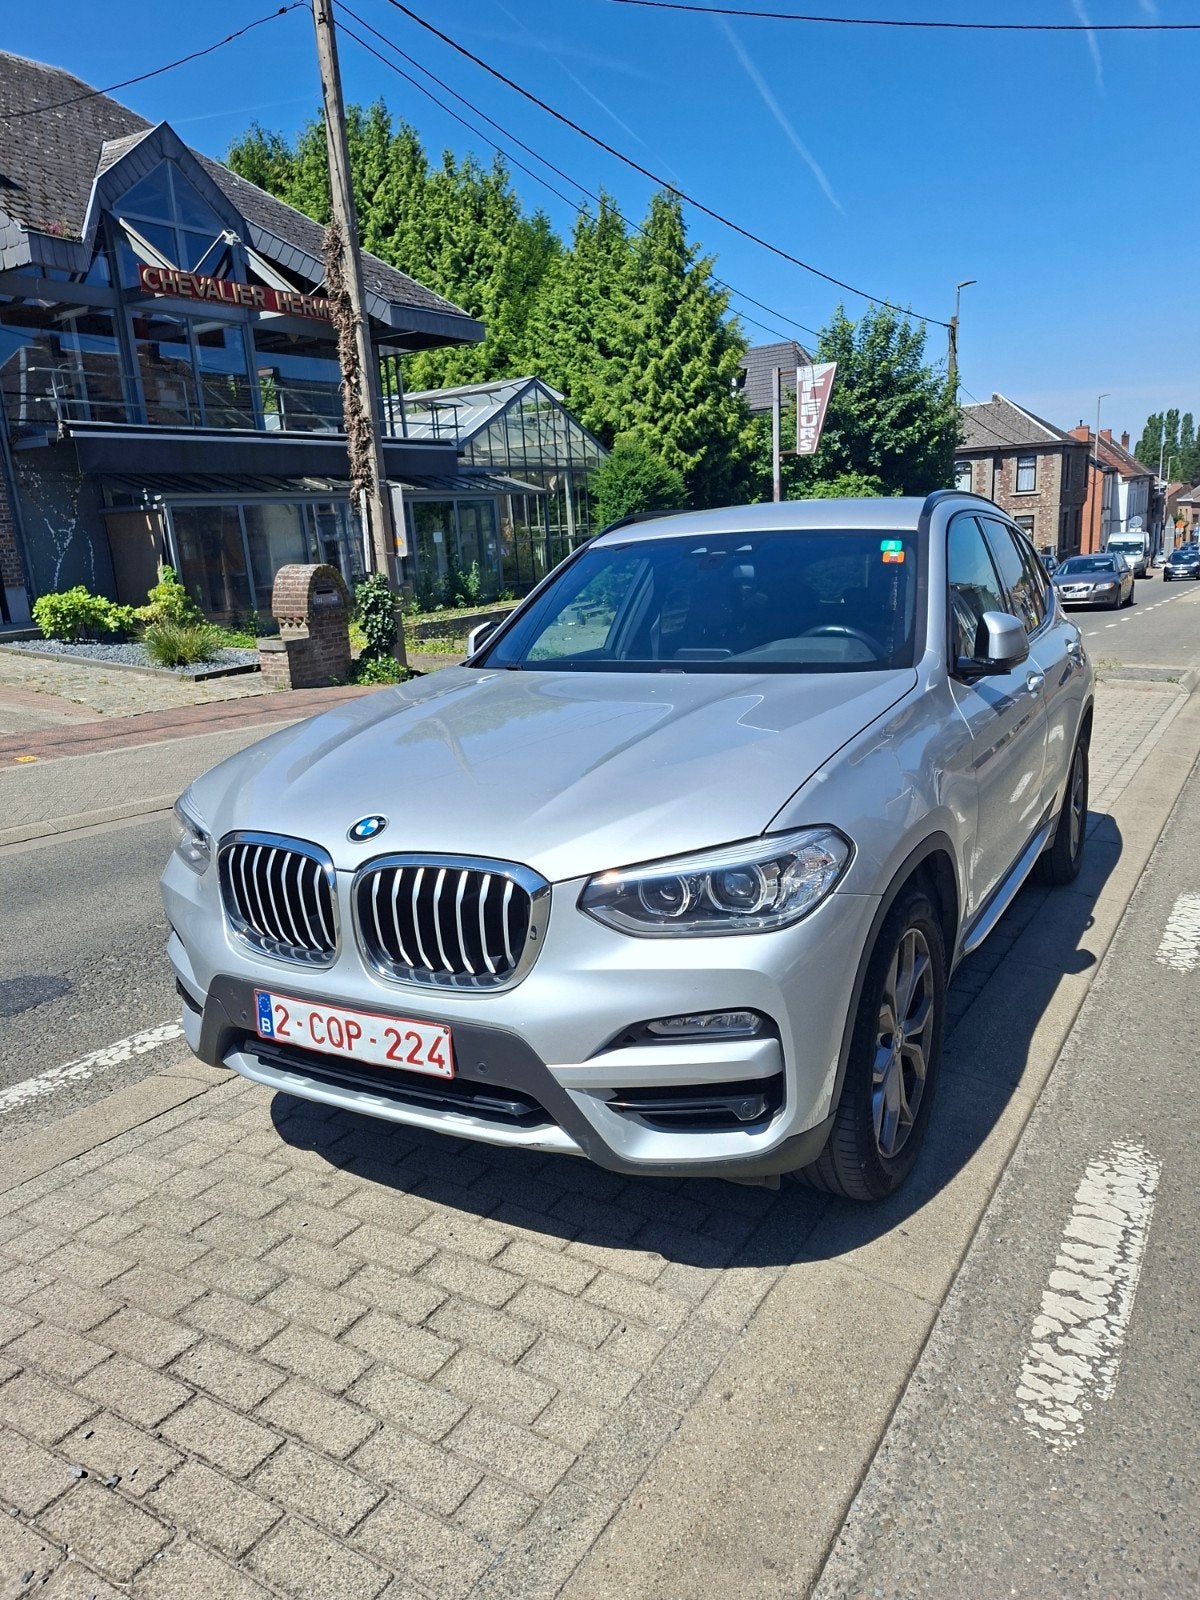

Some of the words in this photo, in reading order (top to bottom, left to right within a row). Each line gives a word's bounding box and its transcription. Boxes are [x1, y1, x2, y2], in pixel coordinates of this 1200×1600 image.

[143, 267, 266, 308] CHEVALIER
[800, 378, 825, 451] FLEURS
[261, 1017, 272, 1033] B
